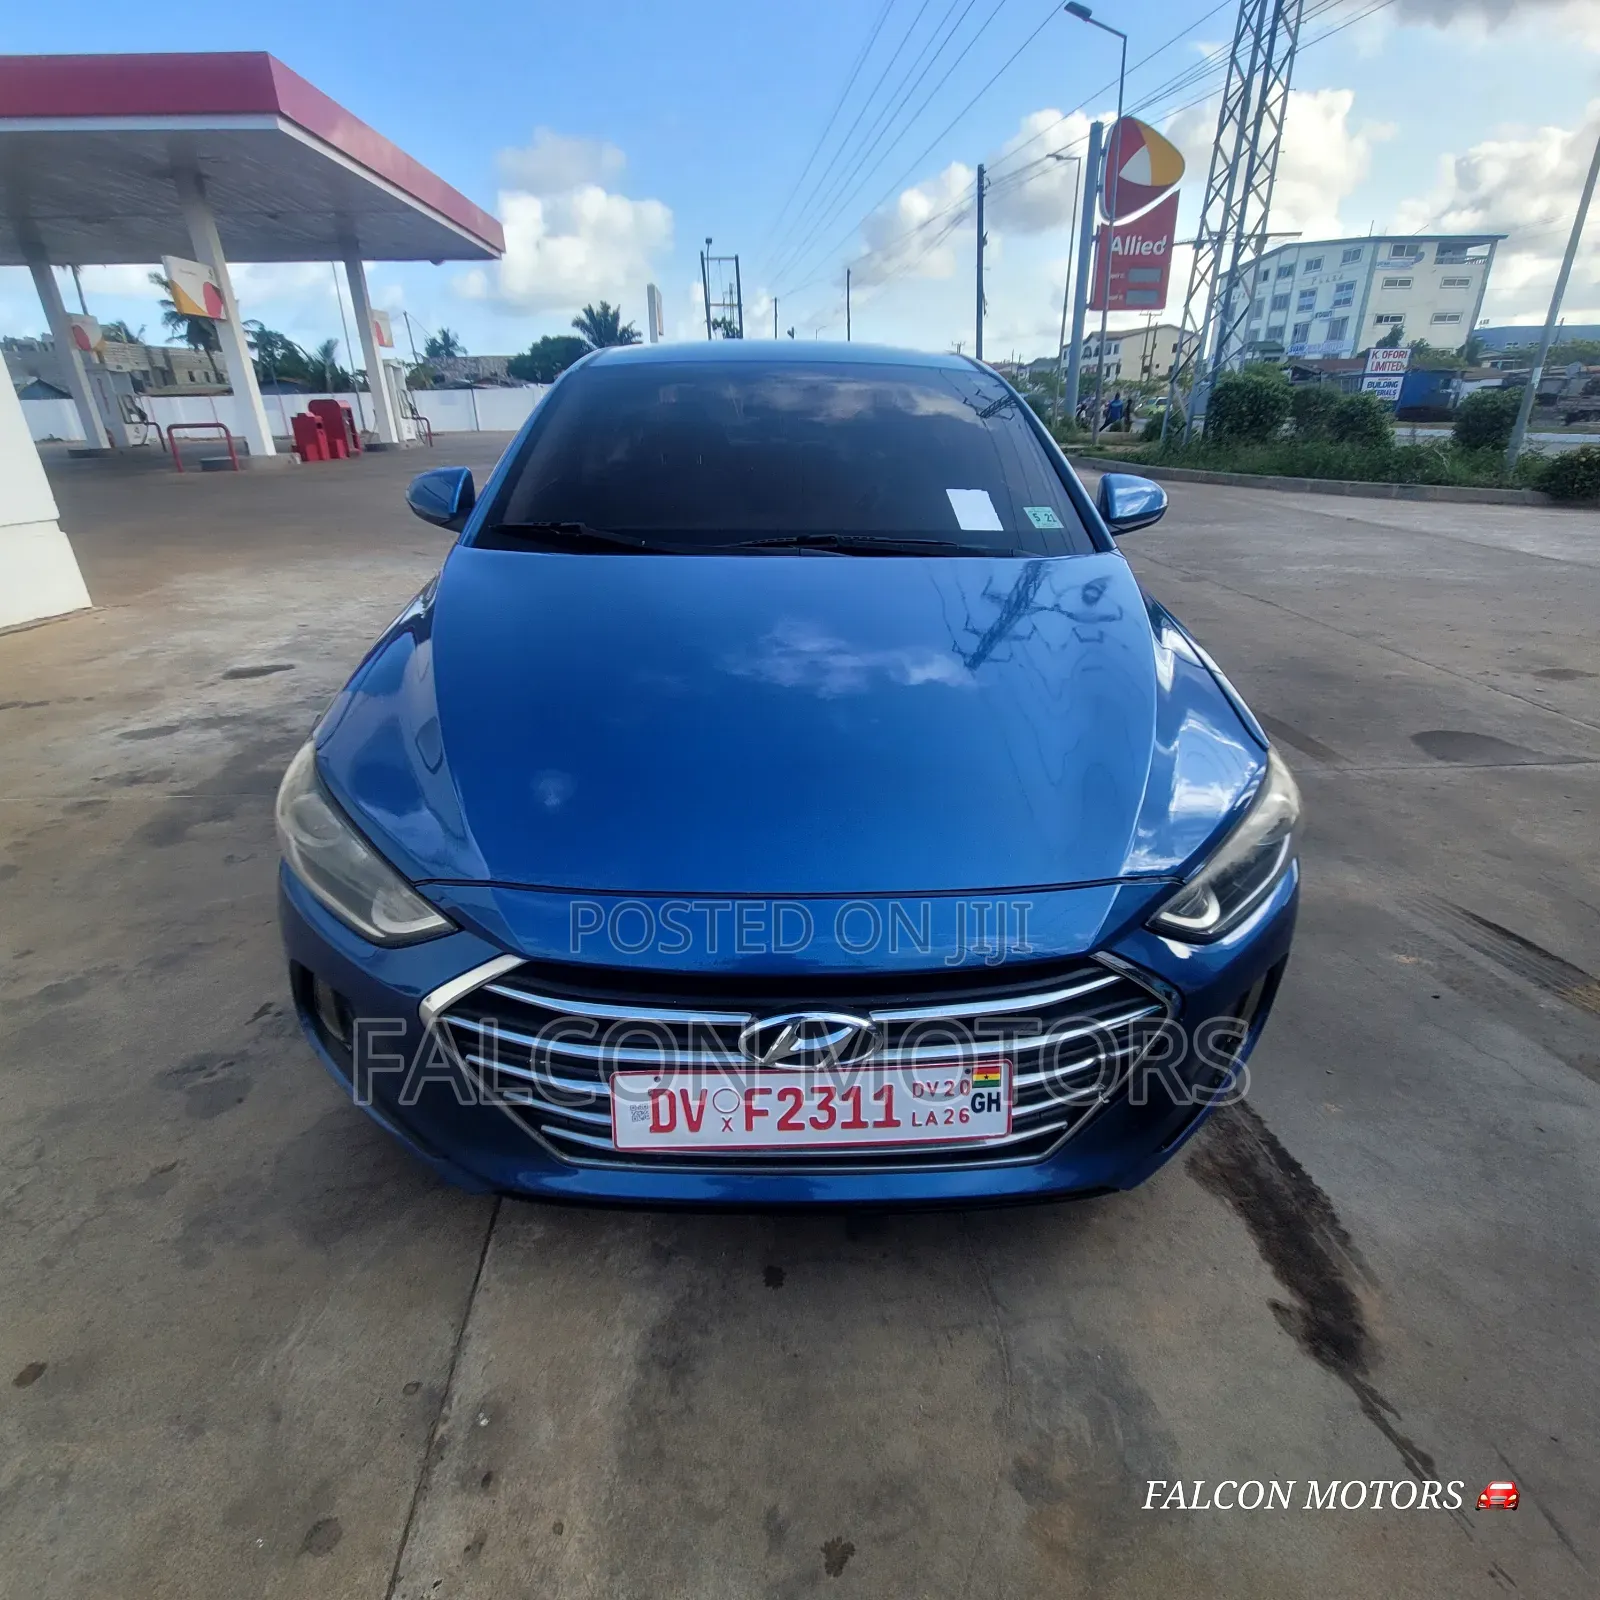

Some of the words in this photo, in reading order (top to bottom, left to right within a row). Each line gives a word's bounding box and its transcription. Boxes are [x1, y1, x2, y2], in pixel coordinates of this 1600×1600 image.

[1111, 234, 1168, 256] Allied
[1371, 350, 1380, 360] K.
[1381, 350, 1409, 360] OFORI
[1370, 360, 1403, 372] LIMITED
[1367, 380, 1398, 389] BUILDING
[1375, 388, 1397, 396] TERIALS
[1032, 513, 1041, 522] 5
[1044, 513, 1058, 523] 21
[970, 1091, 1002, 1114] GH
[648, 1088, 709, 1134] DV
[743, 1084, 902, 1132] F2311
